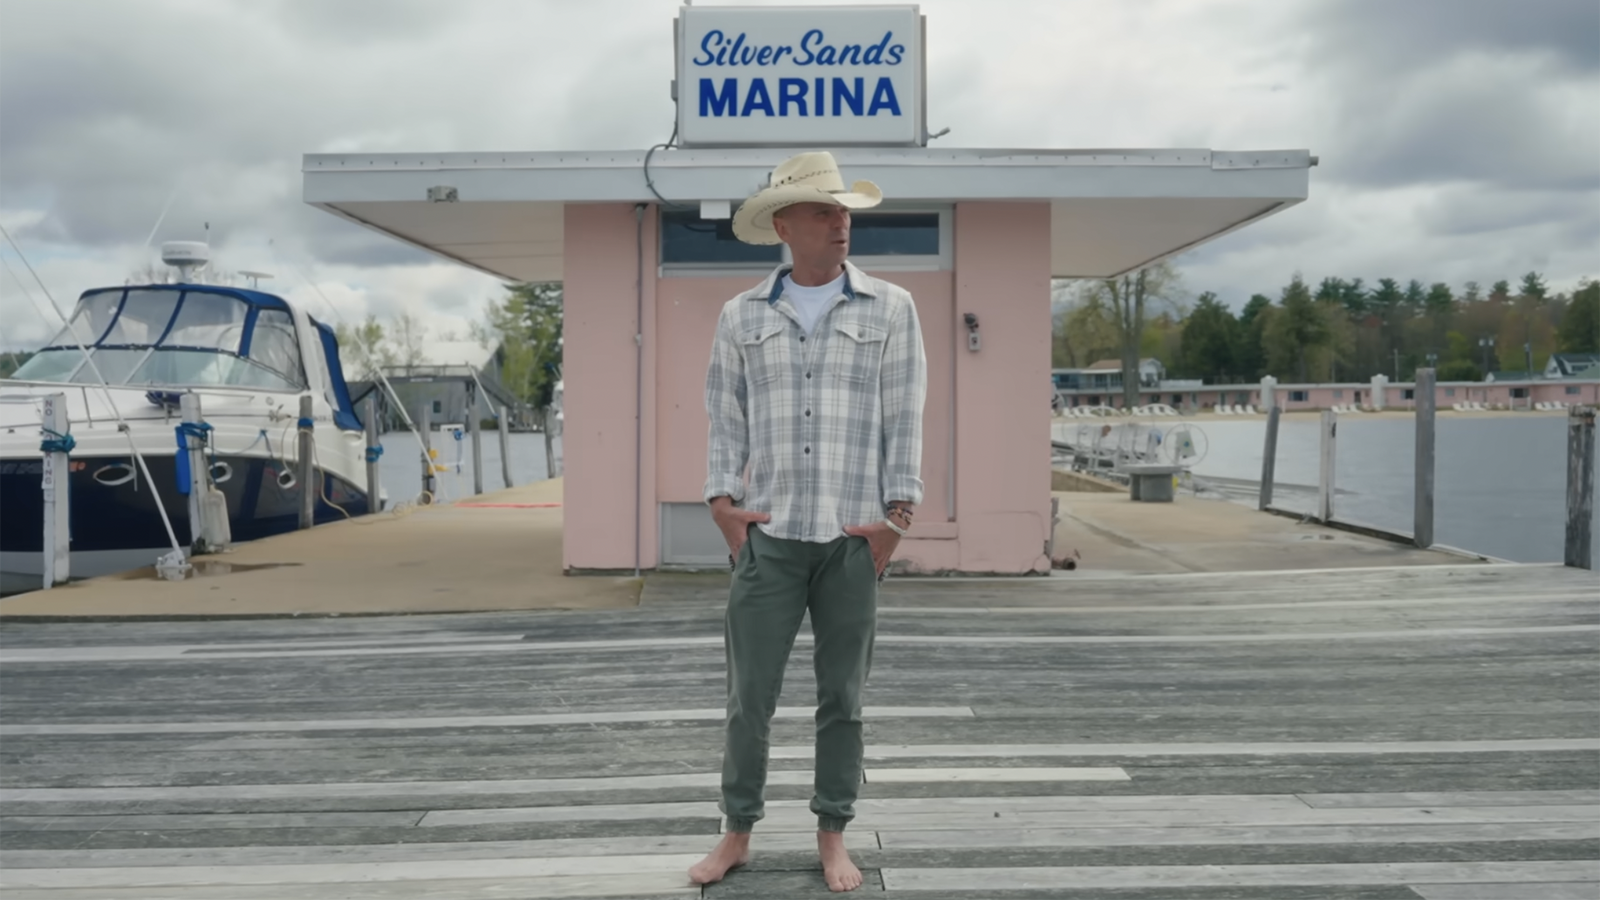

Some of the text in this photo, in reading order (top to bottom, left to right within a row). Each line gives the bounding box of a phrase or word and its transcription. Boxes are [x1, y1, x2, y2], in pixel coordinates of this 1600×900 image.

[693, 29, 905, 66] Silver Sands
[699, 77, 902, 117] MARINA
[44, 399, 53, 416] NO
